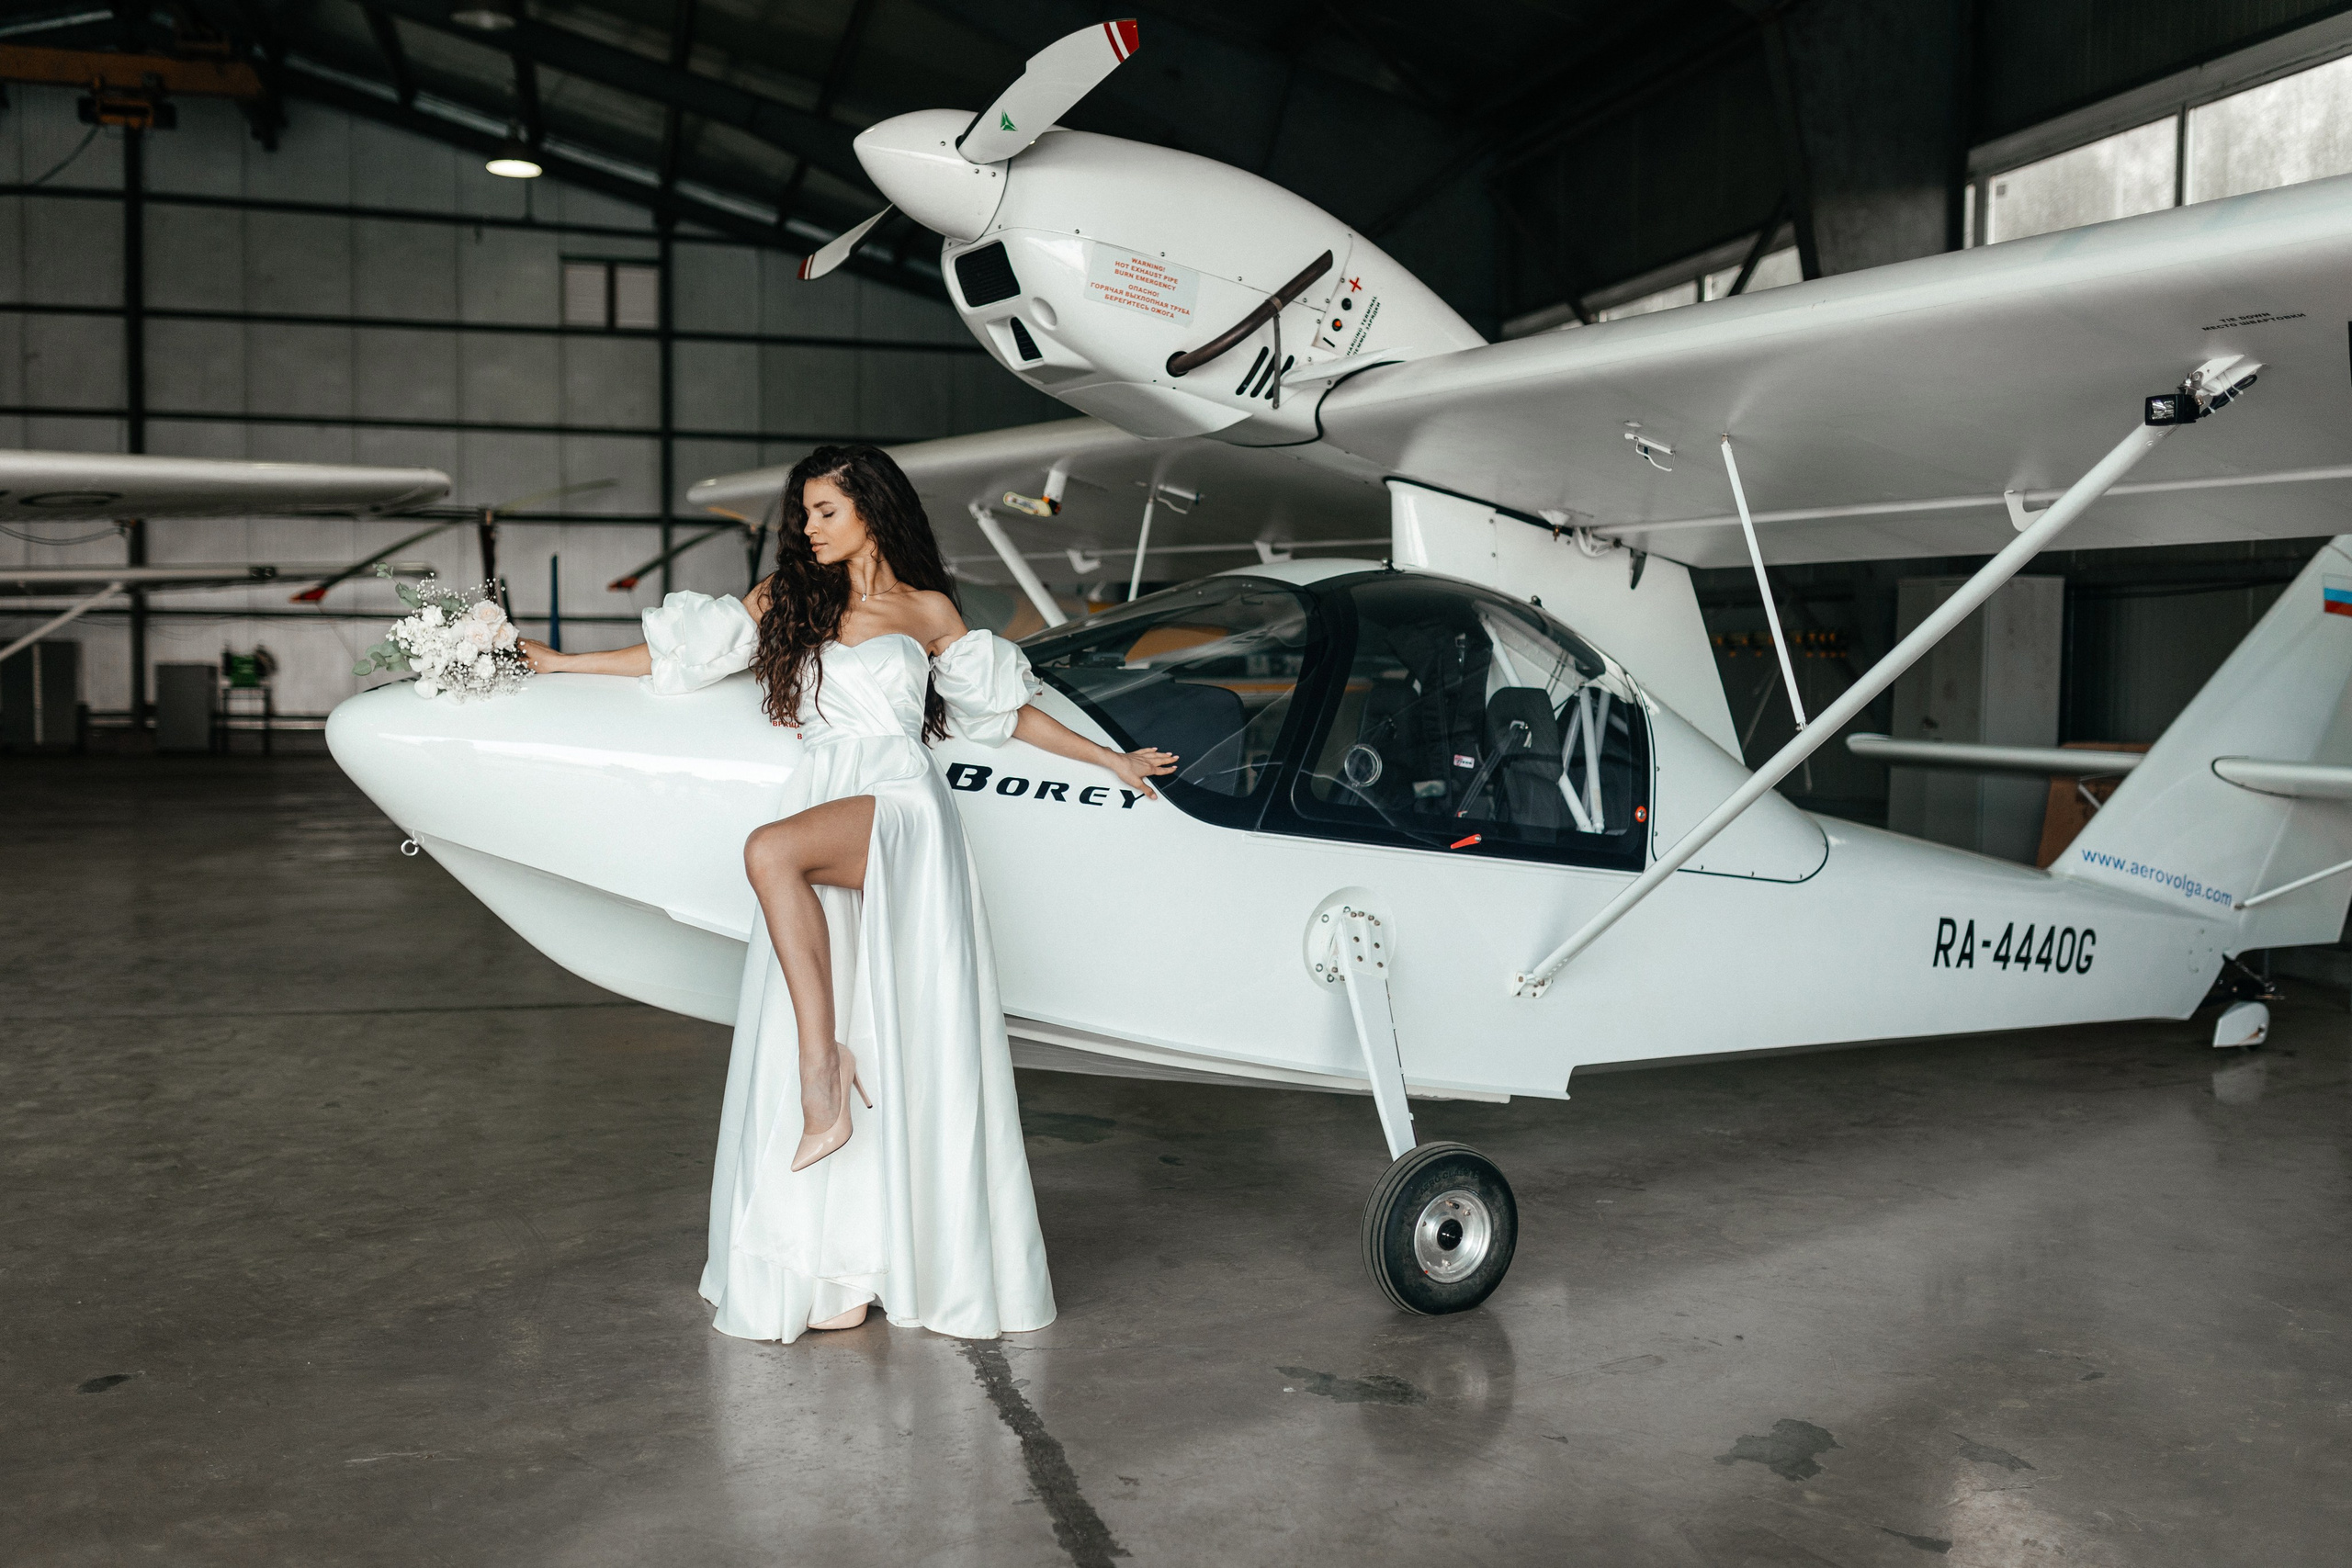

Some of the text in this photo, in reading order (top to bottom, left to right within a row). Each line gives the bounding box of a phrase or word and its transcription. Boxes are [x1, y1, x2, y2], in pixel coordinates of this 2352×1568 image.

[1114, 260, 1179, 285] HOT EXHAUST PIPE
[1131, 257, 1166, 273] WARNING!
[1114, 268, 1177, 291] BURN EMERGENCY
[1127, 284, 1159, 298] ОПАСНО!
[1091, 281, 1191, 316] ГОРЯЧАЯ ВЫХЛОПНАЯ ТРУБА
[1104, 293, 1175, 319] БЕРЕГИТЕСЬ ОЖОГА
[2201, 312, 2307, 332] МЕСТО ШВАРТОВКИ
[2238, 312, 2271, 321] DOWN
[2082, 849, 2233, 908] www.aerovolga.com
[1932, 917, 2097, 975] RA-4440G
